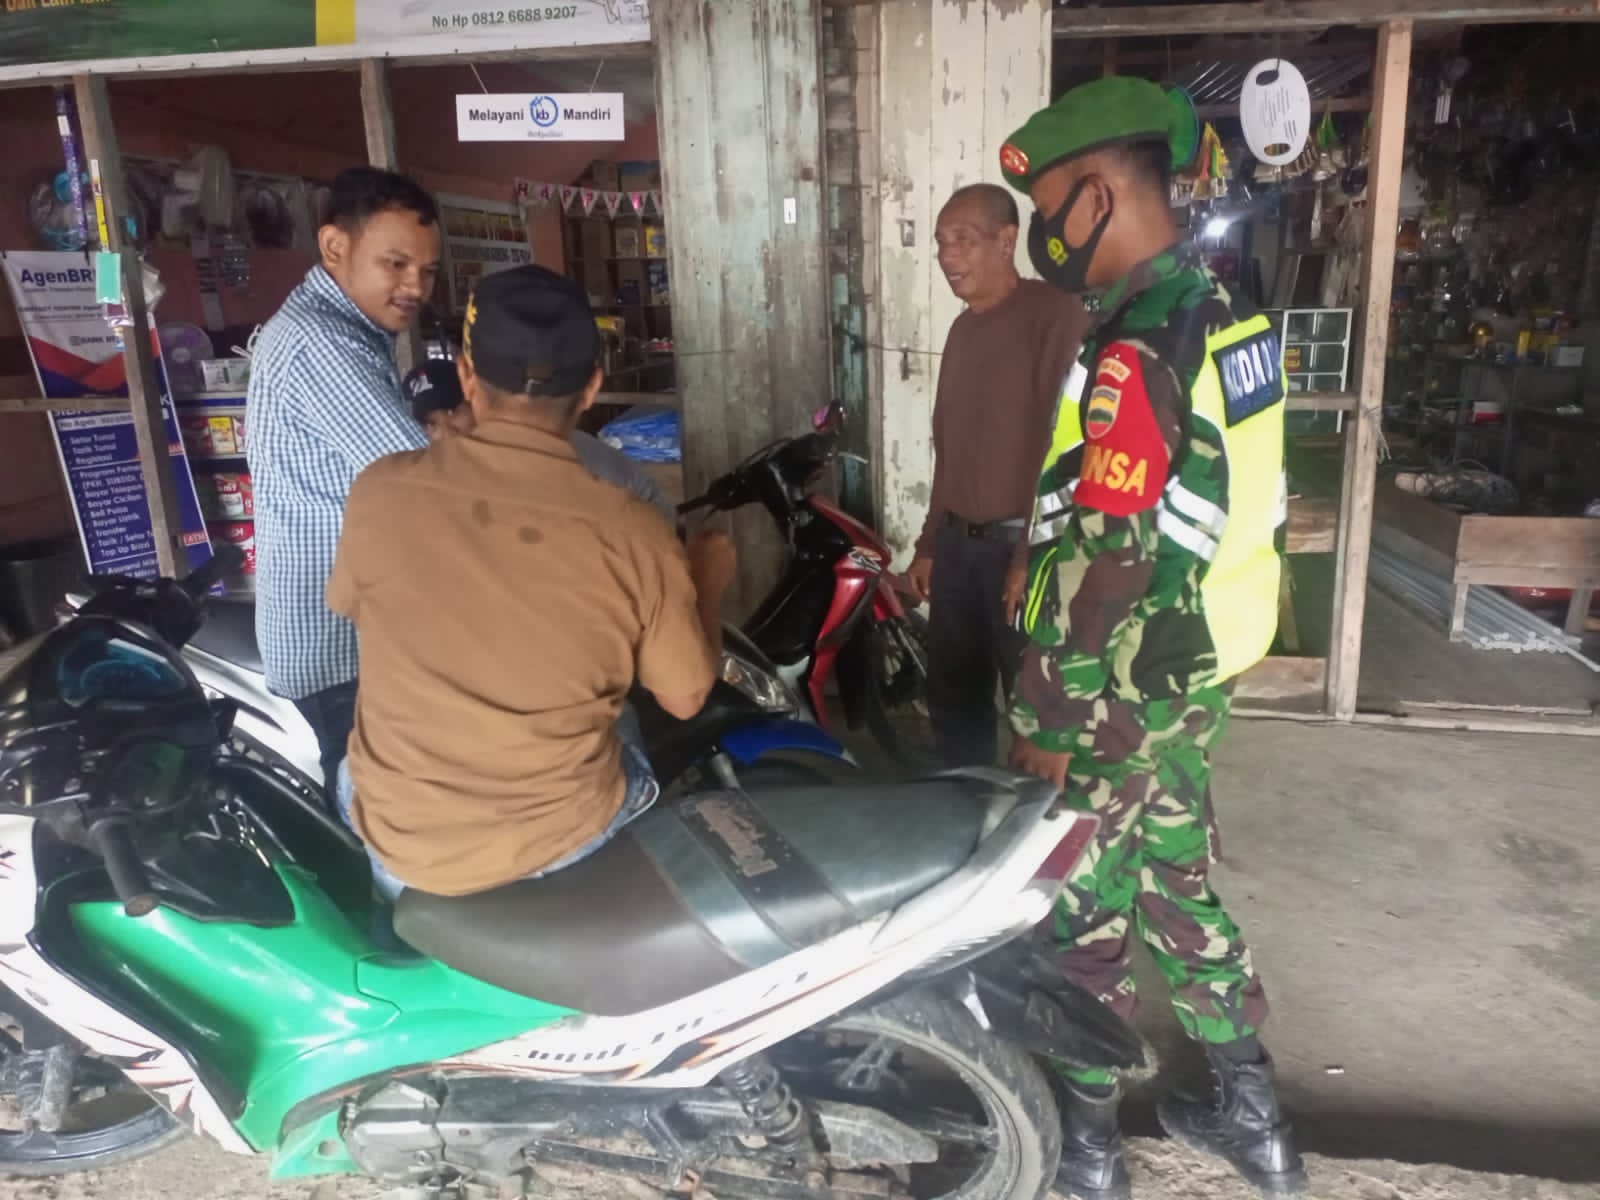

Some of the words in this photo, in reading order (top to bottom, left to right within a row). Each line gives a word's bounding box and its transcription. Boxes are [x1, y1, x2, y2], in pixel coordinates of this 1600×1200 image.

[432, 15, 448, 28] No
[452, 14, 469, 29] Hp
[472, 11, 504, 25] 0812
[508, 8, 541, 23] 6688
[544, 6, 577, 21] 9207
[468, 108, 524, 124] Melayani
[563, 107, 611, 121] Mandiri
[21, 268, 97, 287] AgenBR
